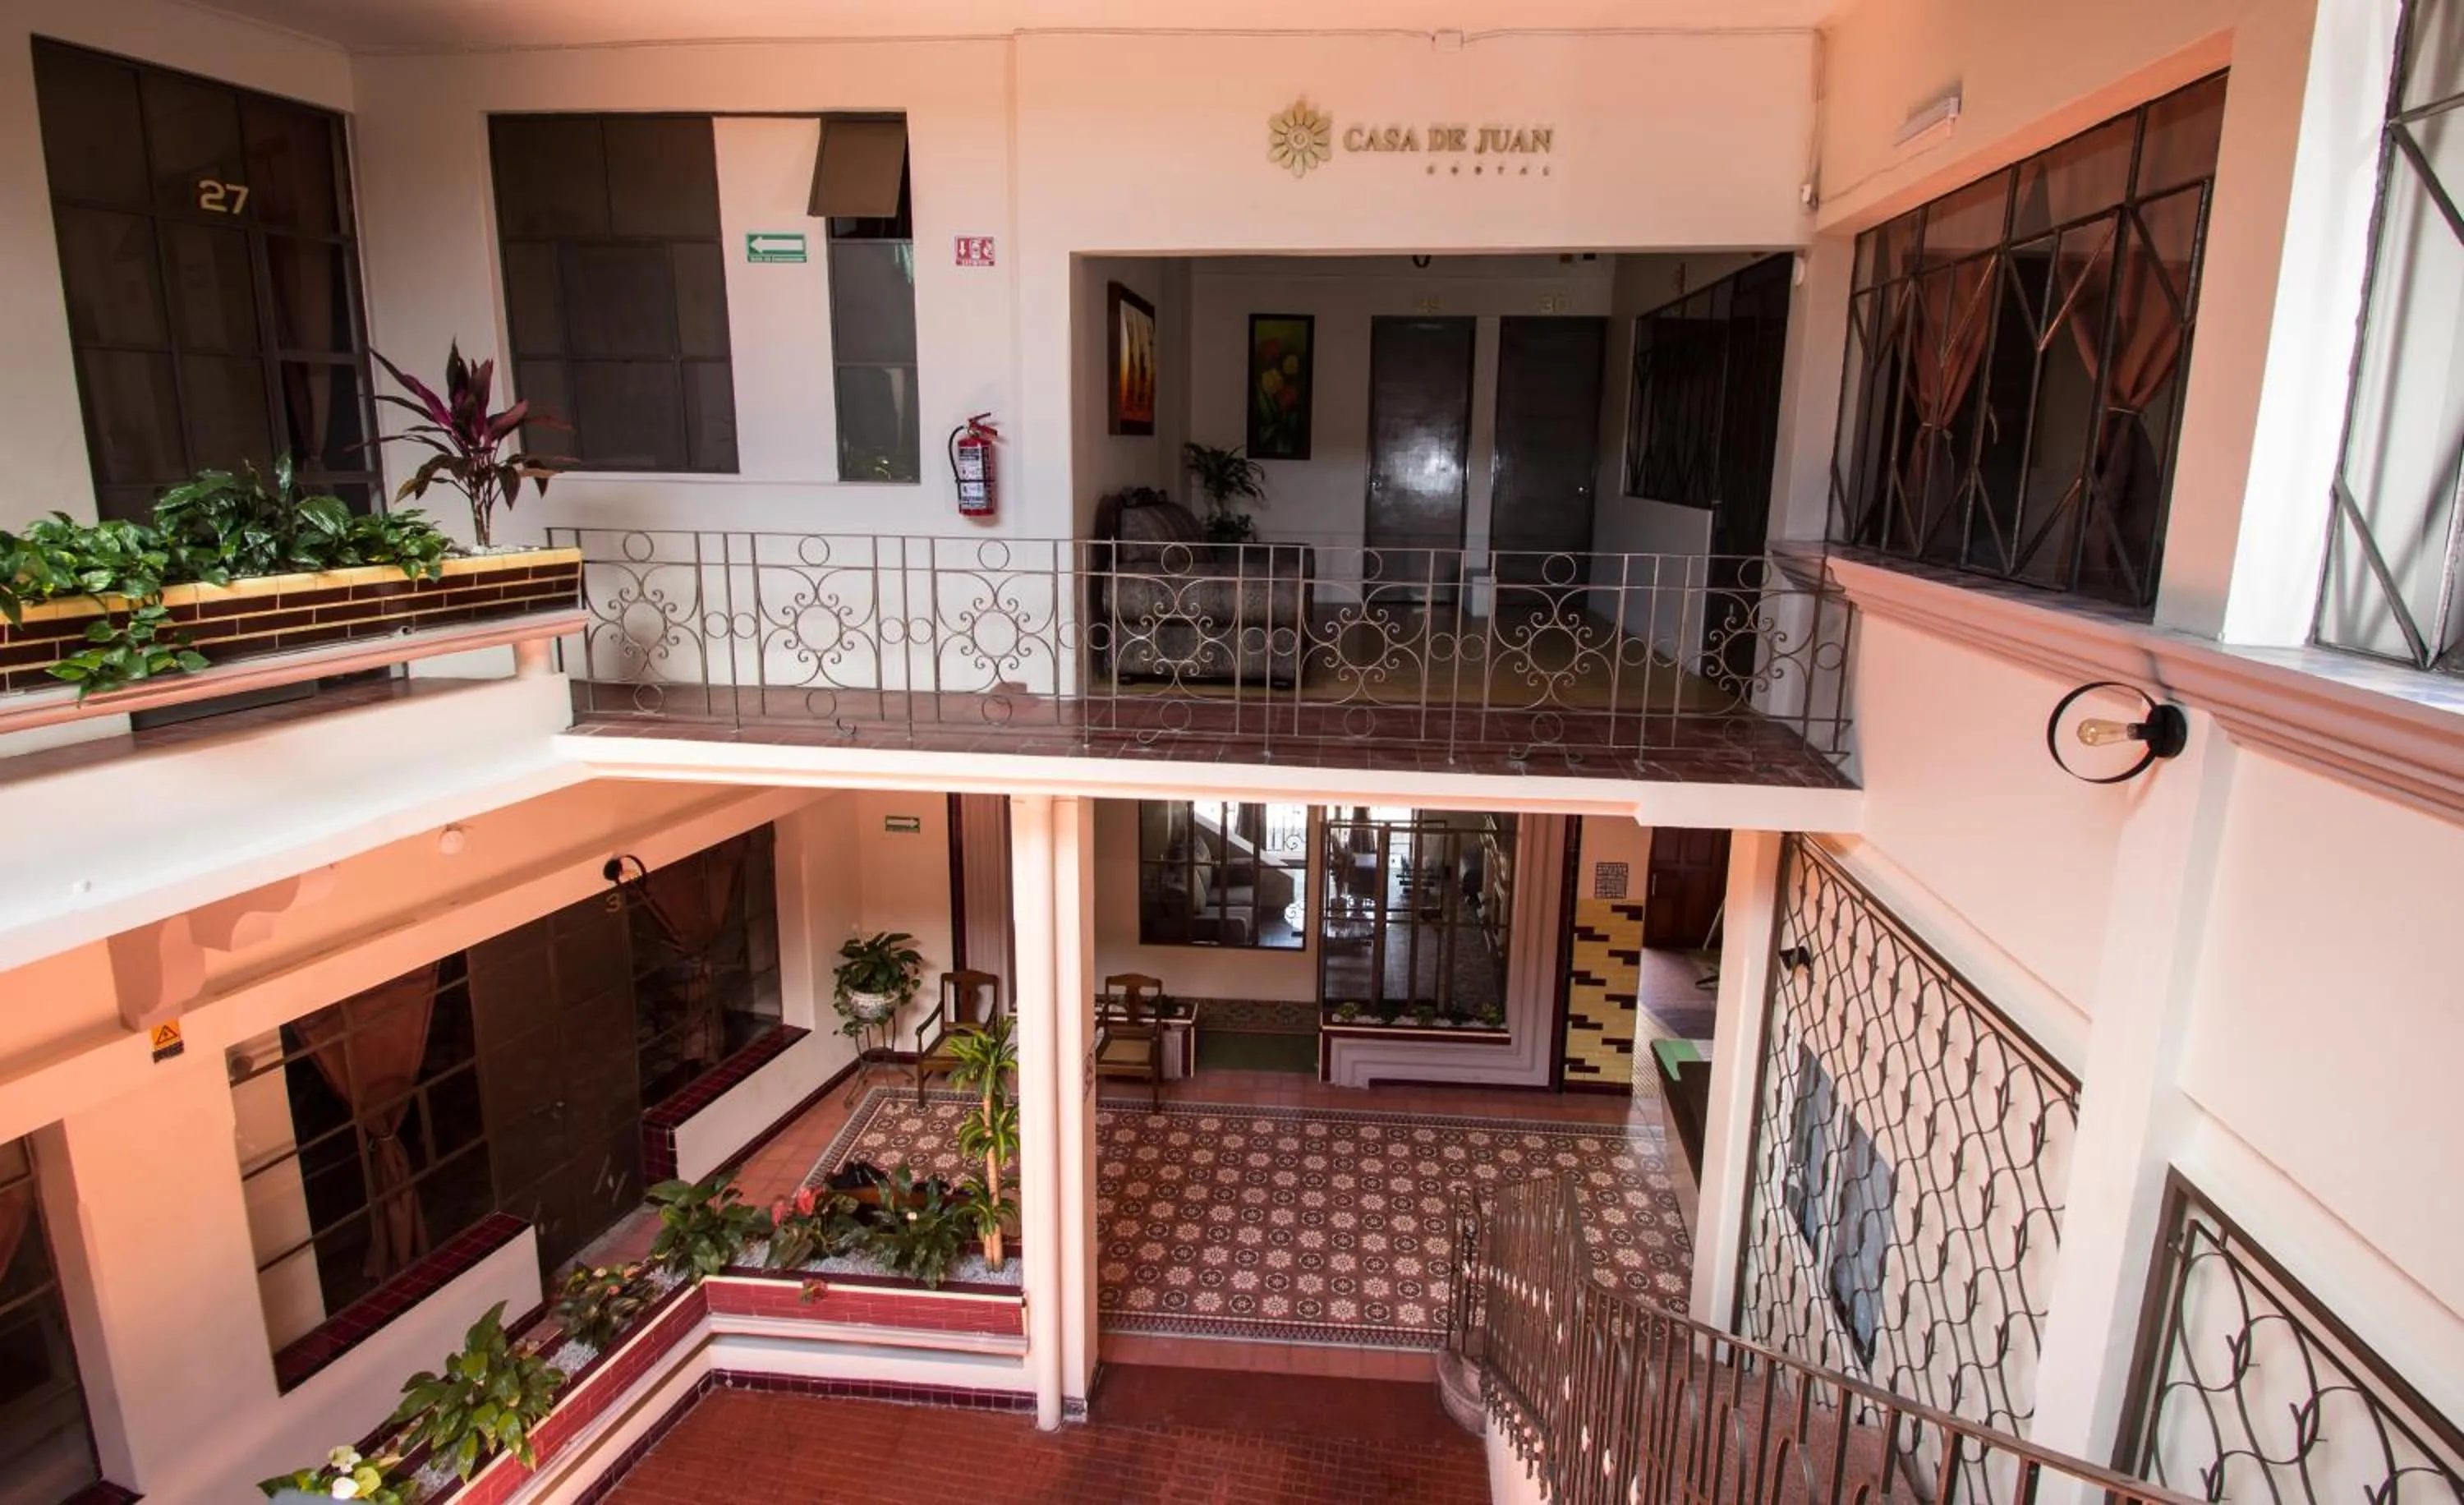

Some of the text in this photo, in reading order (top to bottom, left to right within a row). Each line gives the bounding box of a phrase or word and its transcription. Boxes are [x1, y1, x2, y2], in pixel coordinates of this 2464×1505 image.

[1343, 128, 1553, 154] CASA DE JUAN
[199, 180, 249, 214] 27
